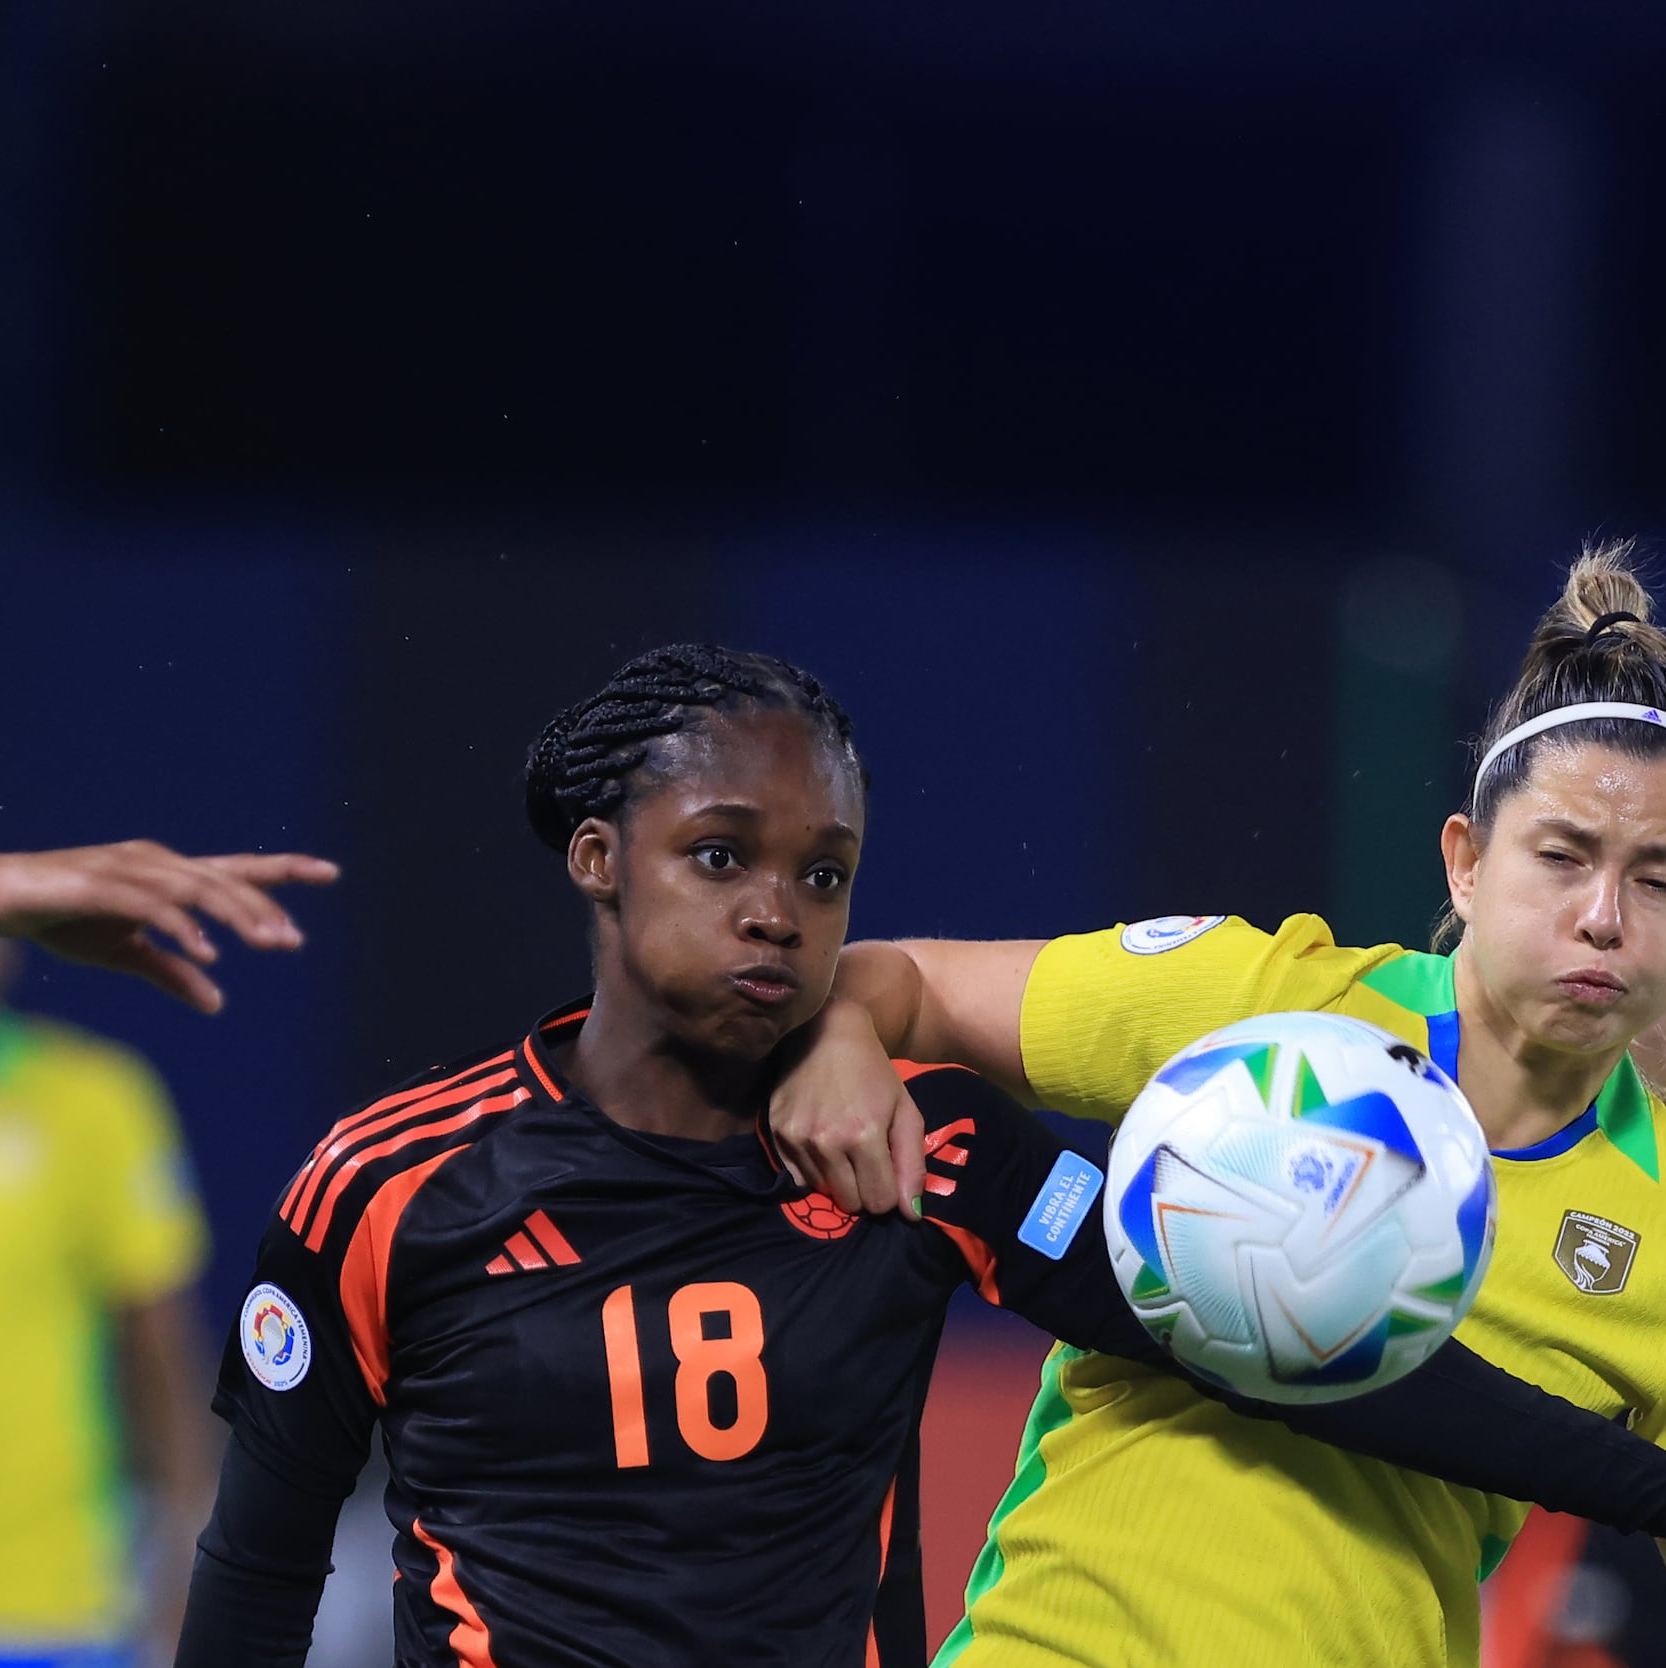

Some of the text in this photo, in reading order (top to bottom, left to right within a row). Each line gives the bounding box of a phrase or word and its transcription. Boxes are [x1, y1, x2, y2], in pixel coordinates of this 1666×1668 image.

[1038, 1174, 1074, 1225] VIBRA EL
[1046, 1170, 1091, 1242] CONTINENTE
[1570, 1211, 1613, 1229] CAMPEÓN
[1613, 1225, 1635, 1240] 2022
[602, 1281, 769, 1469] 18
